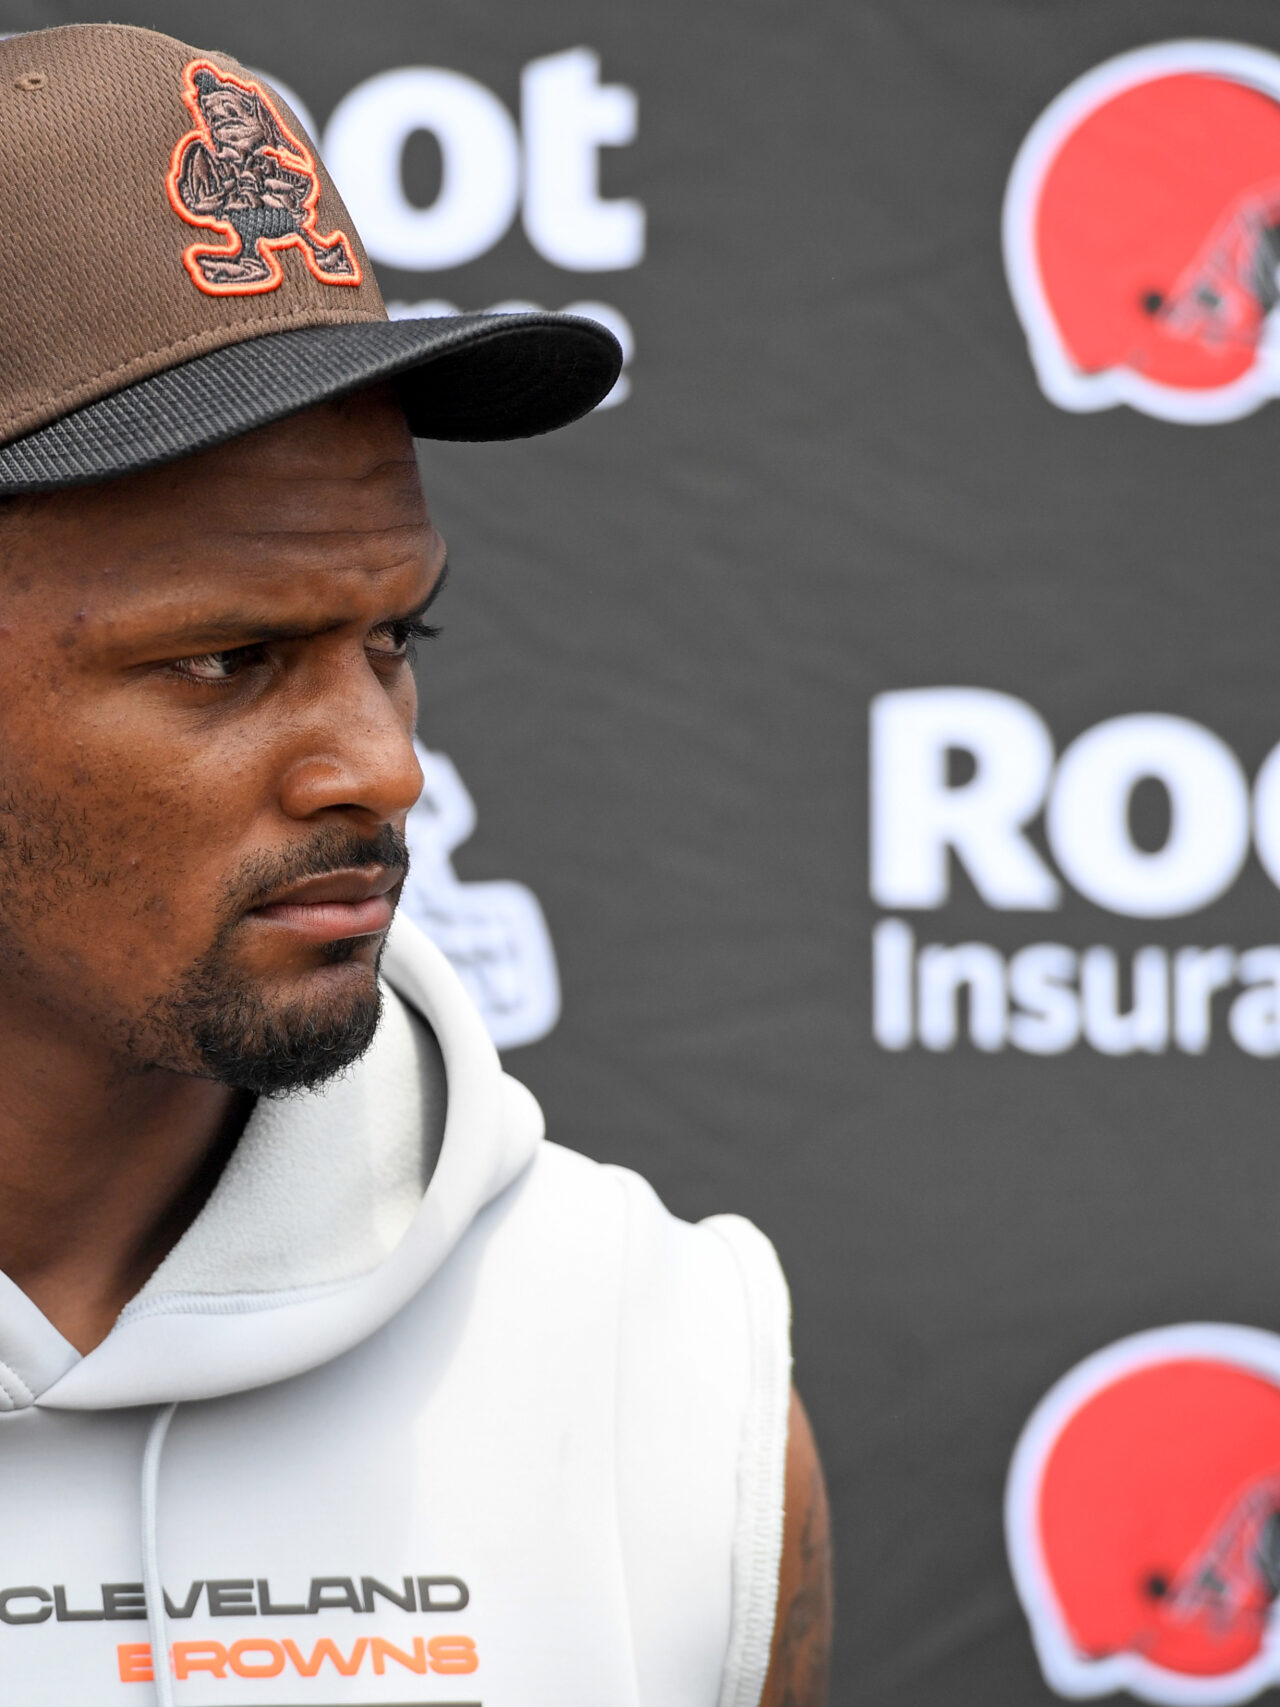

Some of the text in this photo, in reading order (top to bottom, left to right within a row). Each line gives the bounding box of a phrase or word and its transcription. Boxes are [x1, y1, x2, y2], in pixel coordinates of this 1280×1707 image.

[248, 47, 646, 272] ot
[868, 685, 1280, 920] Ro
[872, 917, 1280, 1058] Insura
[116, 1635, 480, 1684] BROWNS
